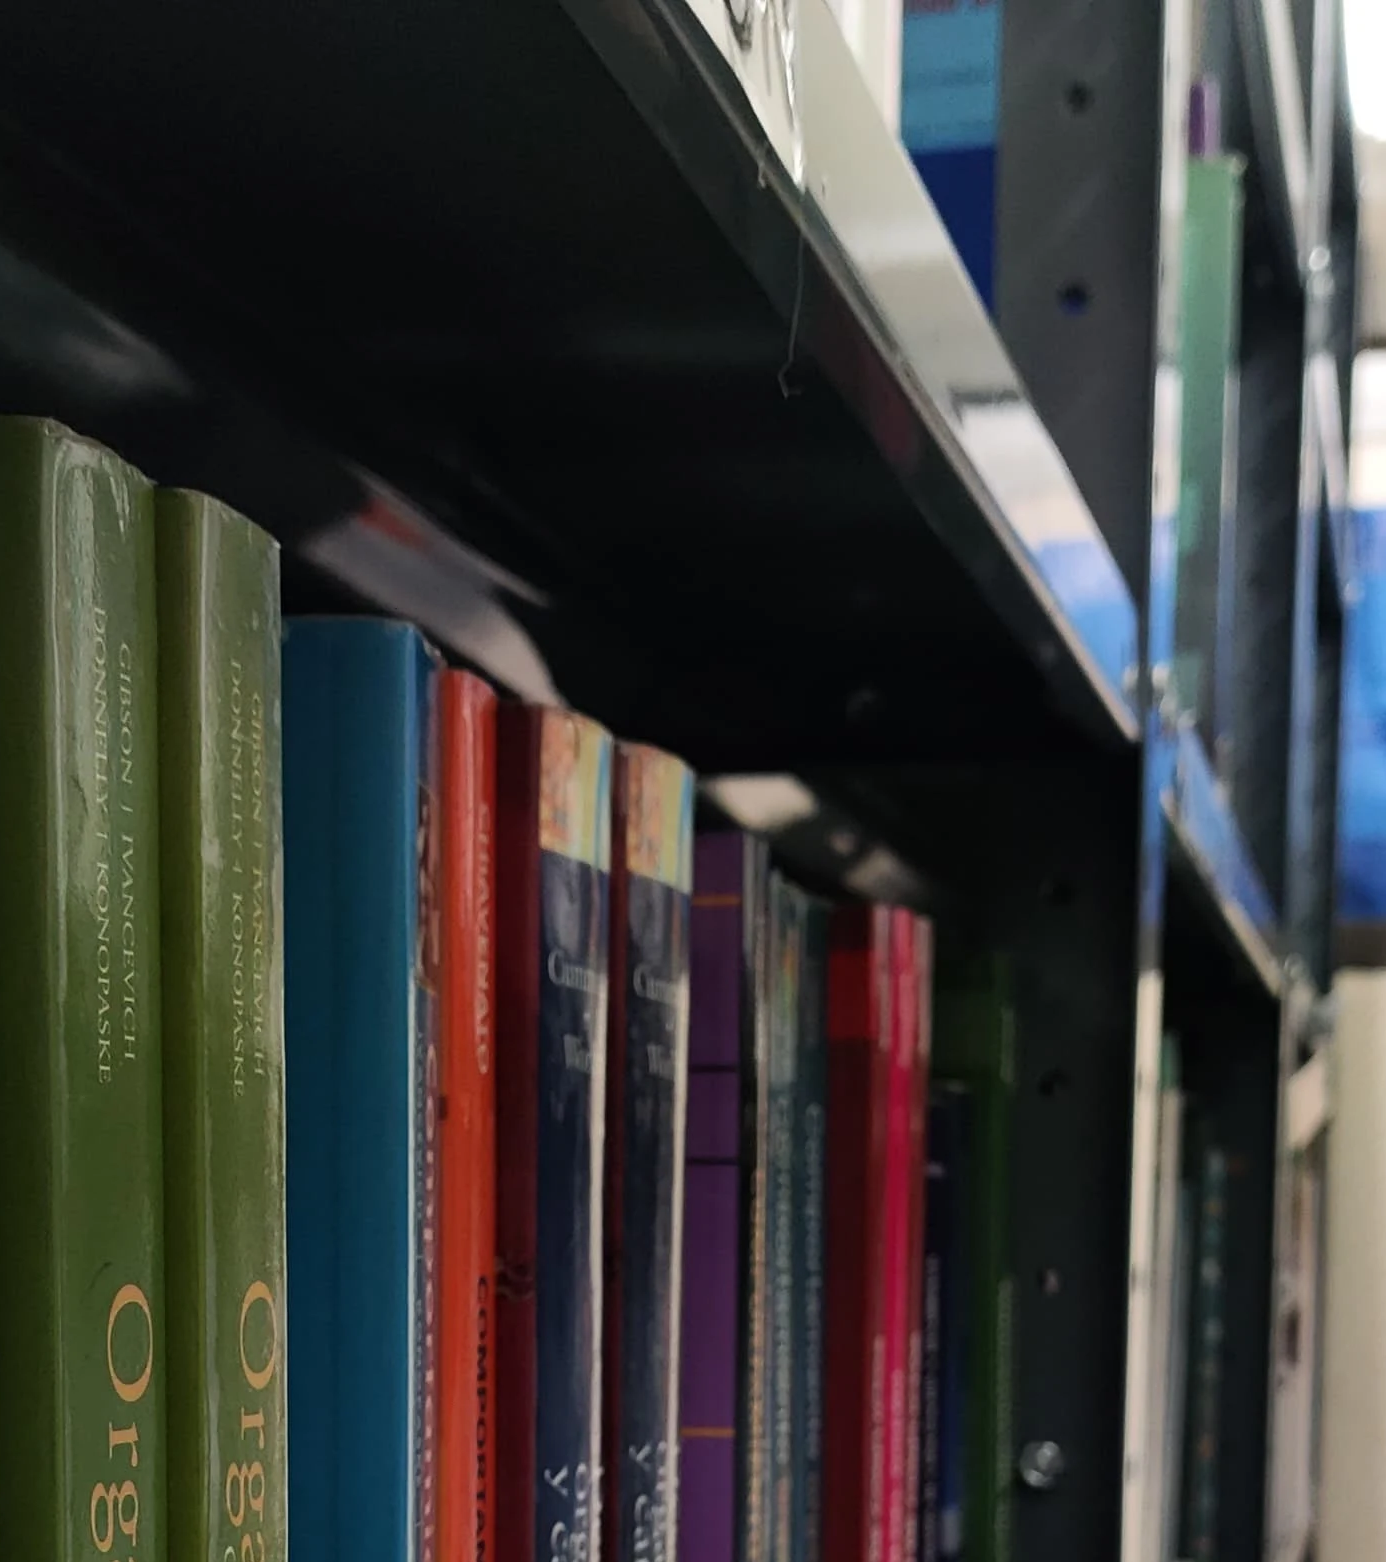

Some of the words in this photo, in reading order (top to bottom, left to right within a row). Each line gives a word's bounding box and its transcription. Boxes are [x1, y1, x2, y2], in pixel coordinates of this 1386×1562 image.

[92, 607, 110, 823] DONNELLY
[117, 642, 134, 785] GIBSON
[94, 862, 112, 1084] KONOPASKE
[120, 831, 137, 1062] IVANCEVICH
[230, 890, 247, 1098] KONOPASKE
[544, 1465, 569, 1497] y
[628, 1441, 652, 1471] y
